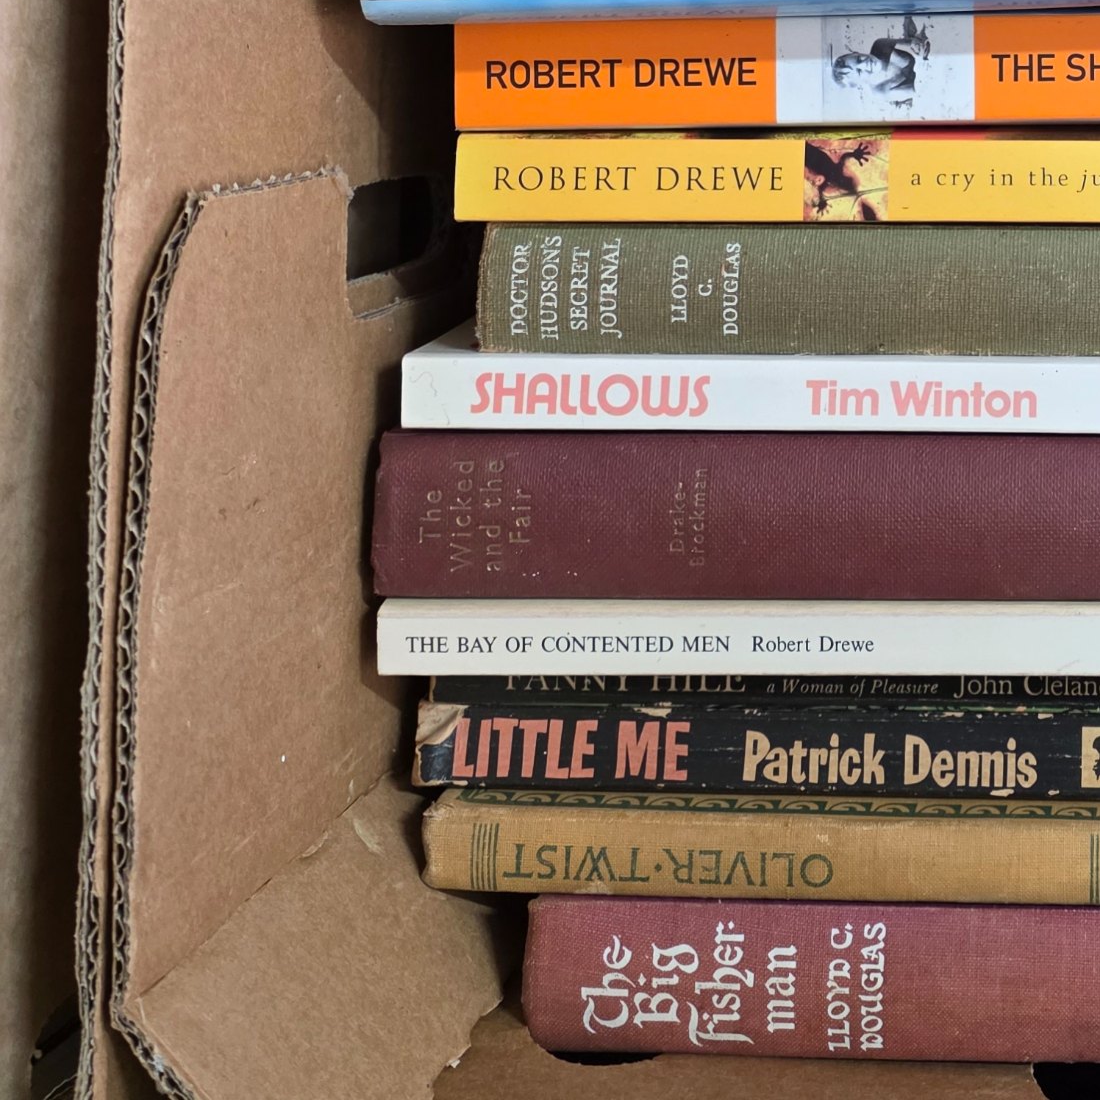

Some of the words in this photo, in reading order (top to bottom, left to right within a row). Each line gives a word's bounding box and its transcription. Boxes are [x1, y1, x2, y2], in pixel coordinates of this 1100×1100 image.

[486, 59, 623, 89] ROBERT
[634, 57, 757, 87] DREWE
[991, 53, 1055, 82] THE
[493, 166, 637, 192] ROBERT
[656, 166, 784, 191] DREWE
[910, 173, 922, 186] a
[936, 171, 975, 191] cry
[990, 168, 1014, 186] in
[1029, 168, 1069, 187] the
[510, 241, 532, 336] DOCTOR
[540, 235, 562, 341] HUDSON'S
[570, 246, 590, 331] SECRET
[600, 238, 623, 338] JOURNAL
[671, 255, 688, 323] LLOYD
[698, 278, 713, 297] C.
[723, 242, 742, 336] DOUGLAS
[470, 372, 711, 418] SHALLOWS
[806, 380, 879, 417] Tim
[890, 380, 1038, 419] Winton
[419, 489, 442, 543] The
[450, 460, 475, 573] Wicked
[480, 458, 504, 515] the
[509, 487, 531, 544] Fair
[689, 469, 707, 566] Brockman
[480, 524, 503, 572] and
[406, 636, 449, 653] THE
[457, 636, 497, 653] BAY
[505, 636, 533, 653] OF
[541, 636, 673, 653] CONTENTED
[681, 636, 730, 653] MEN
[751, 634, 811, 653] Robert
[819, 635, 874, 653] Drewe
[782, 680, 844, 695] Woman
[850, 678, 866, 696] of
[870, 679, 939, 695] Pleasure
[953, 676, 1013, 699] John
[452, 718, 598, 780] LITTLE
[615, 720, 691, 781] ME
[742, 729, 885, 786] Patrick
[904, 734, 1038, 789] Dennis
[831, 923, 853, 949] C.
[581, 935, 636, 1034] The
[633, 943, 699, 1028] Big
[764, 944, 798, 1033] man
[828, 959, 850, 1051] LLOYD
[860, 922, 886, 1051] DOUGLAS
